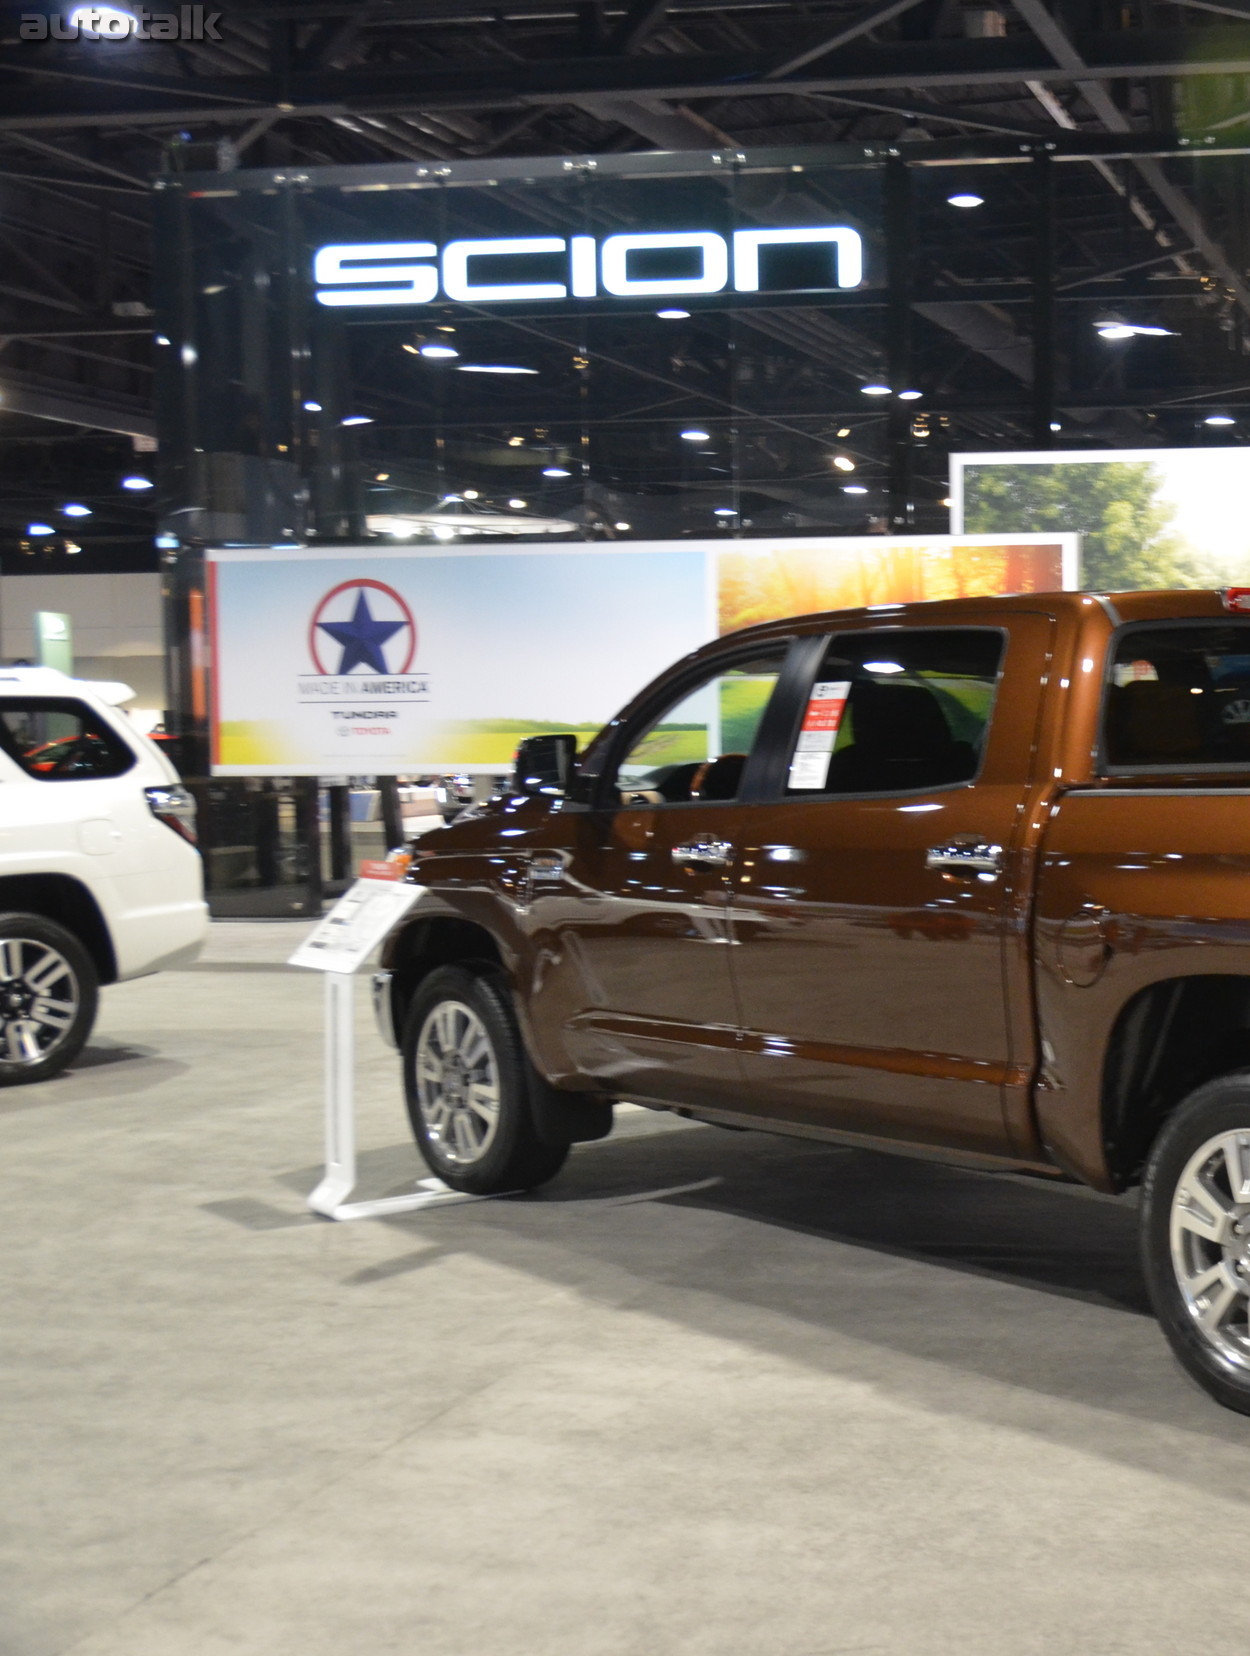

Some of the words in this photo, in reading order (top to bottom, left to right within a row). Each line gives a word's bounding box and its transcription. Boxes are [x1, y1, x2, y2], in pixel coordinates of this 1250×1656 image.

[314, 225, 864, 307] SCION
[298, 682, 340, 695] MADE
[343, 681, 357, 694] IN
[362, 680, 429, 694] AMERICA
[330, 711, 398, 720] TUNDRA
[352, 727, 391, 735] TOYOTA
